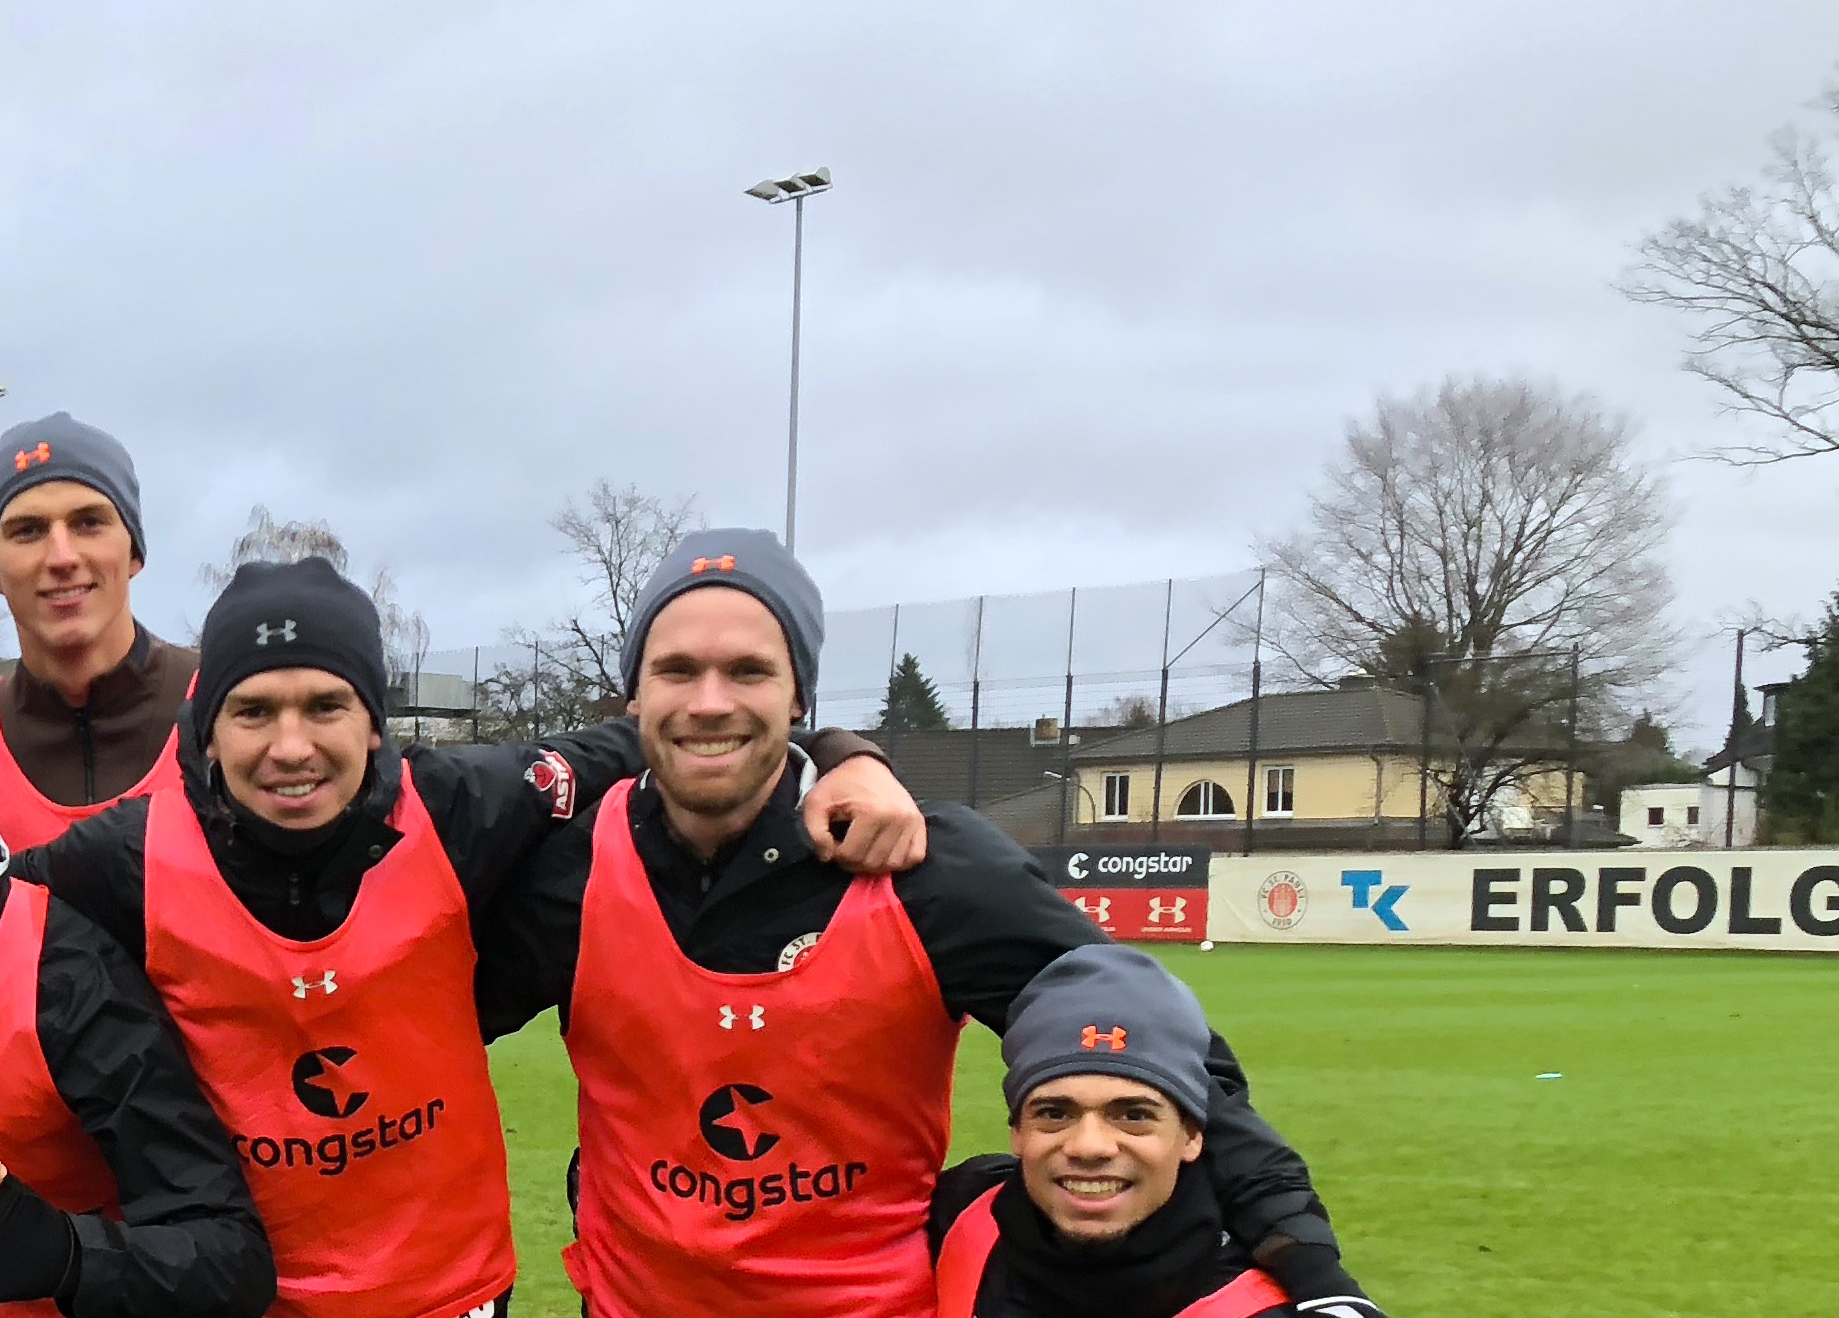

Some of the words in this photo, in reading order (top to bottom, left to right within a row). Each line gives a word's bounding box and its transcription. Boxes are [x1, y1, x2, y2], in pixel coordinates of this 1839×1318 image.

[1098, 852, 1193, 879] congstar
[1341, 869, 1410, 931] TK
[781, 952, 794, 965] FC
[650, 1160, 868, 1219] congstar
